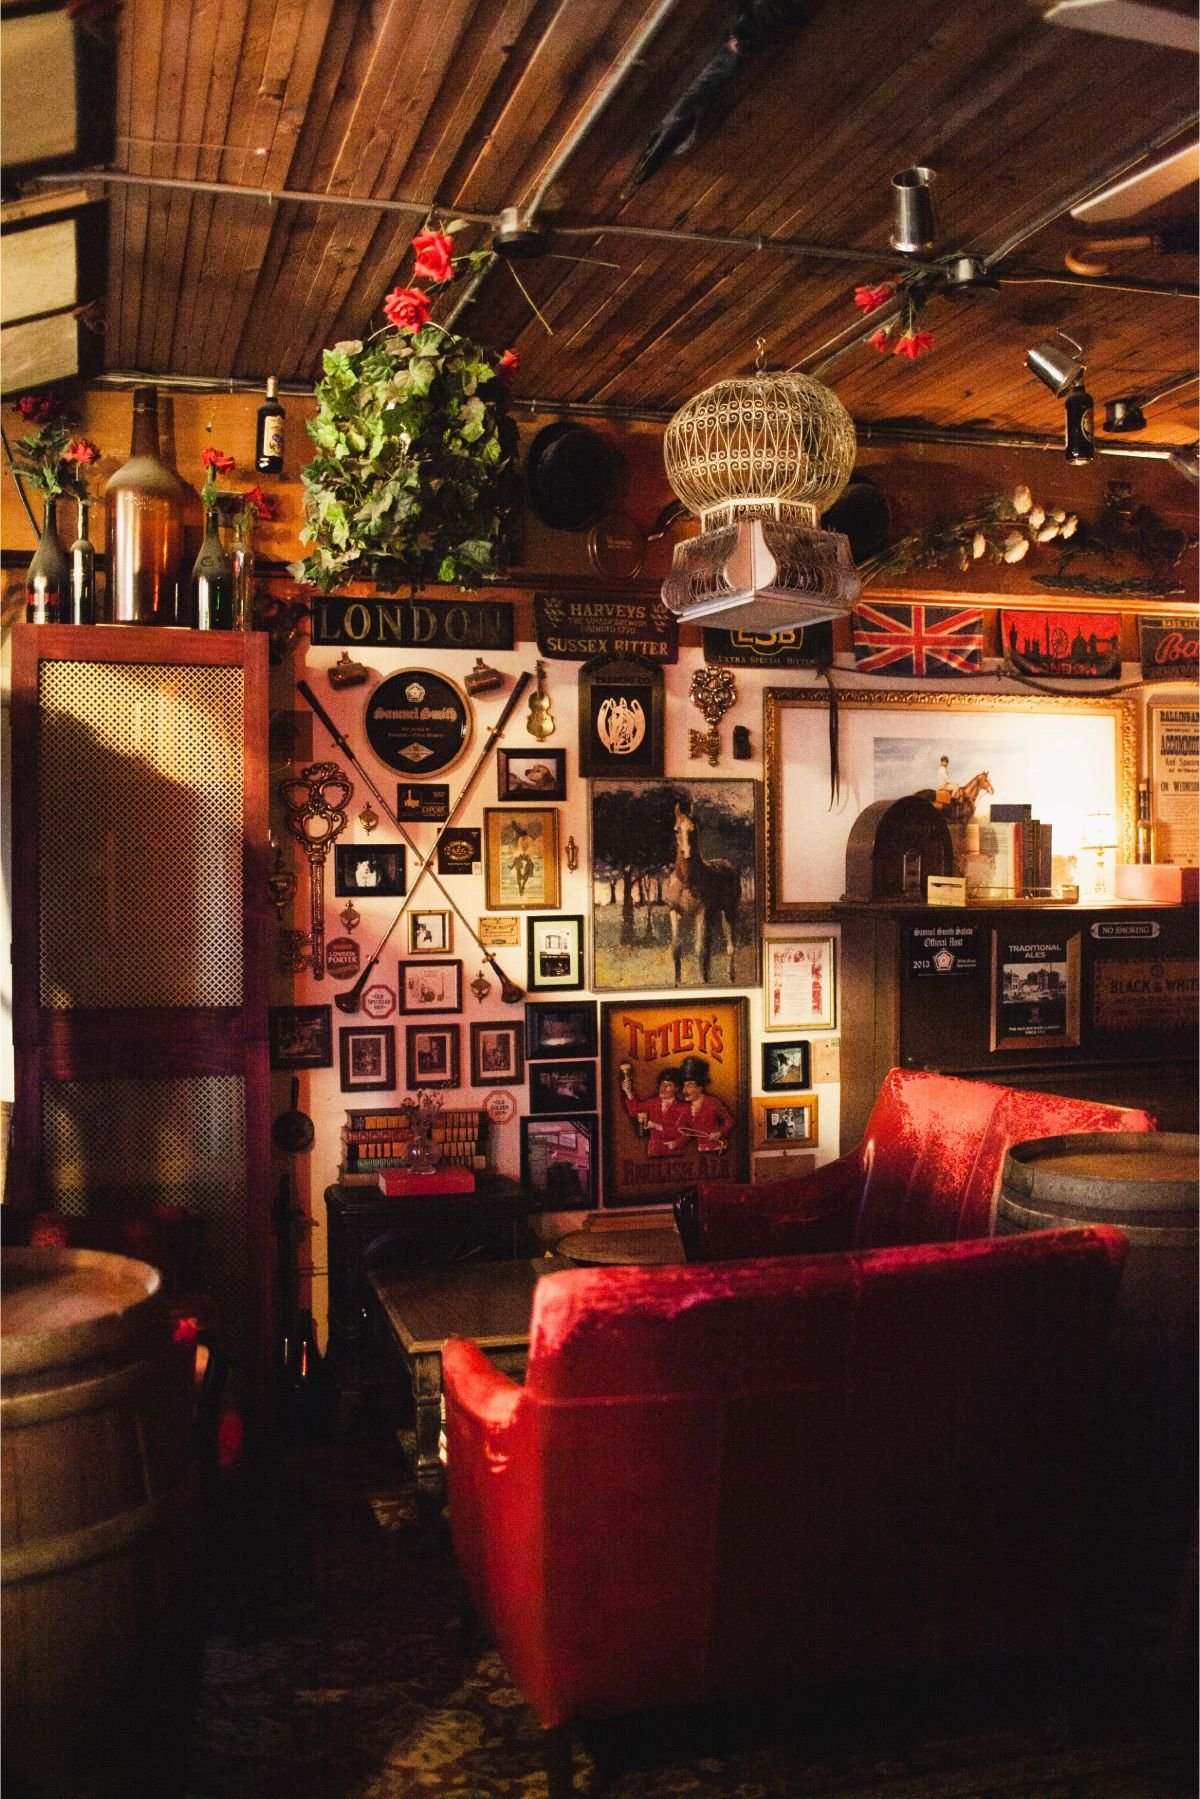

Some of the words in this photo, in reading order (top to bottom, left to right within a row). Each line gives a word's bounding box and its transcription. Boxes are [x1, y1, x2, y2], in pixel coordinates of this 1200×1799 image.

[570, 603, 646, 618] HARVEYS
[320, 603, 501, 642] LONDON
[546, 636, 608, 653] SUSSEX
[614, 639, 669, 656] BITTER
[1101, 926, 1114, 934] NO
[1115, 926, 1150, 934] SMOKING
[1008, 944, 1061, 952] TRADITIONAL
[913, 959, 930, 969] 2013
[622, 1015, 724, 1064] TETLEY'S
